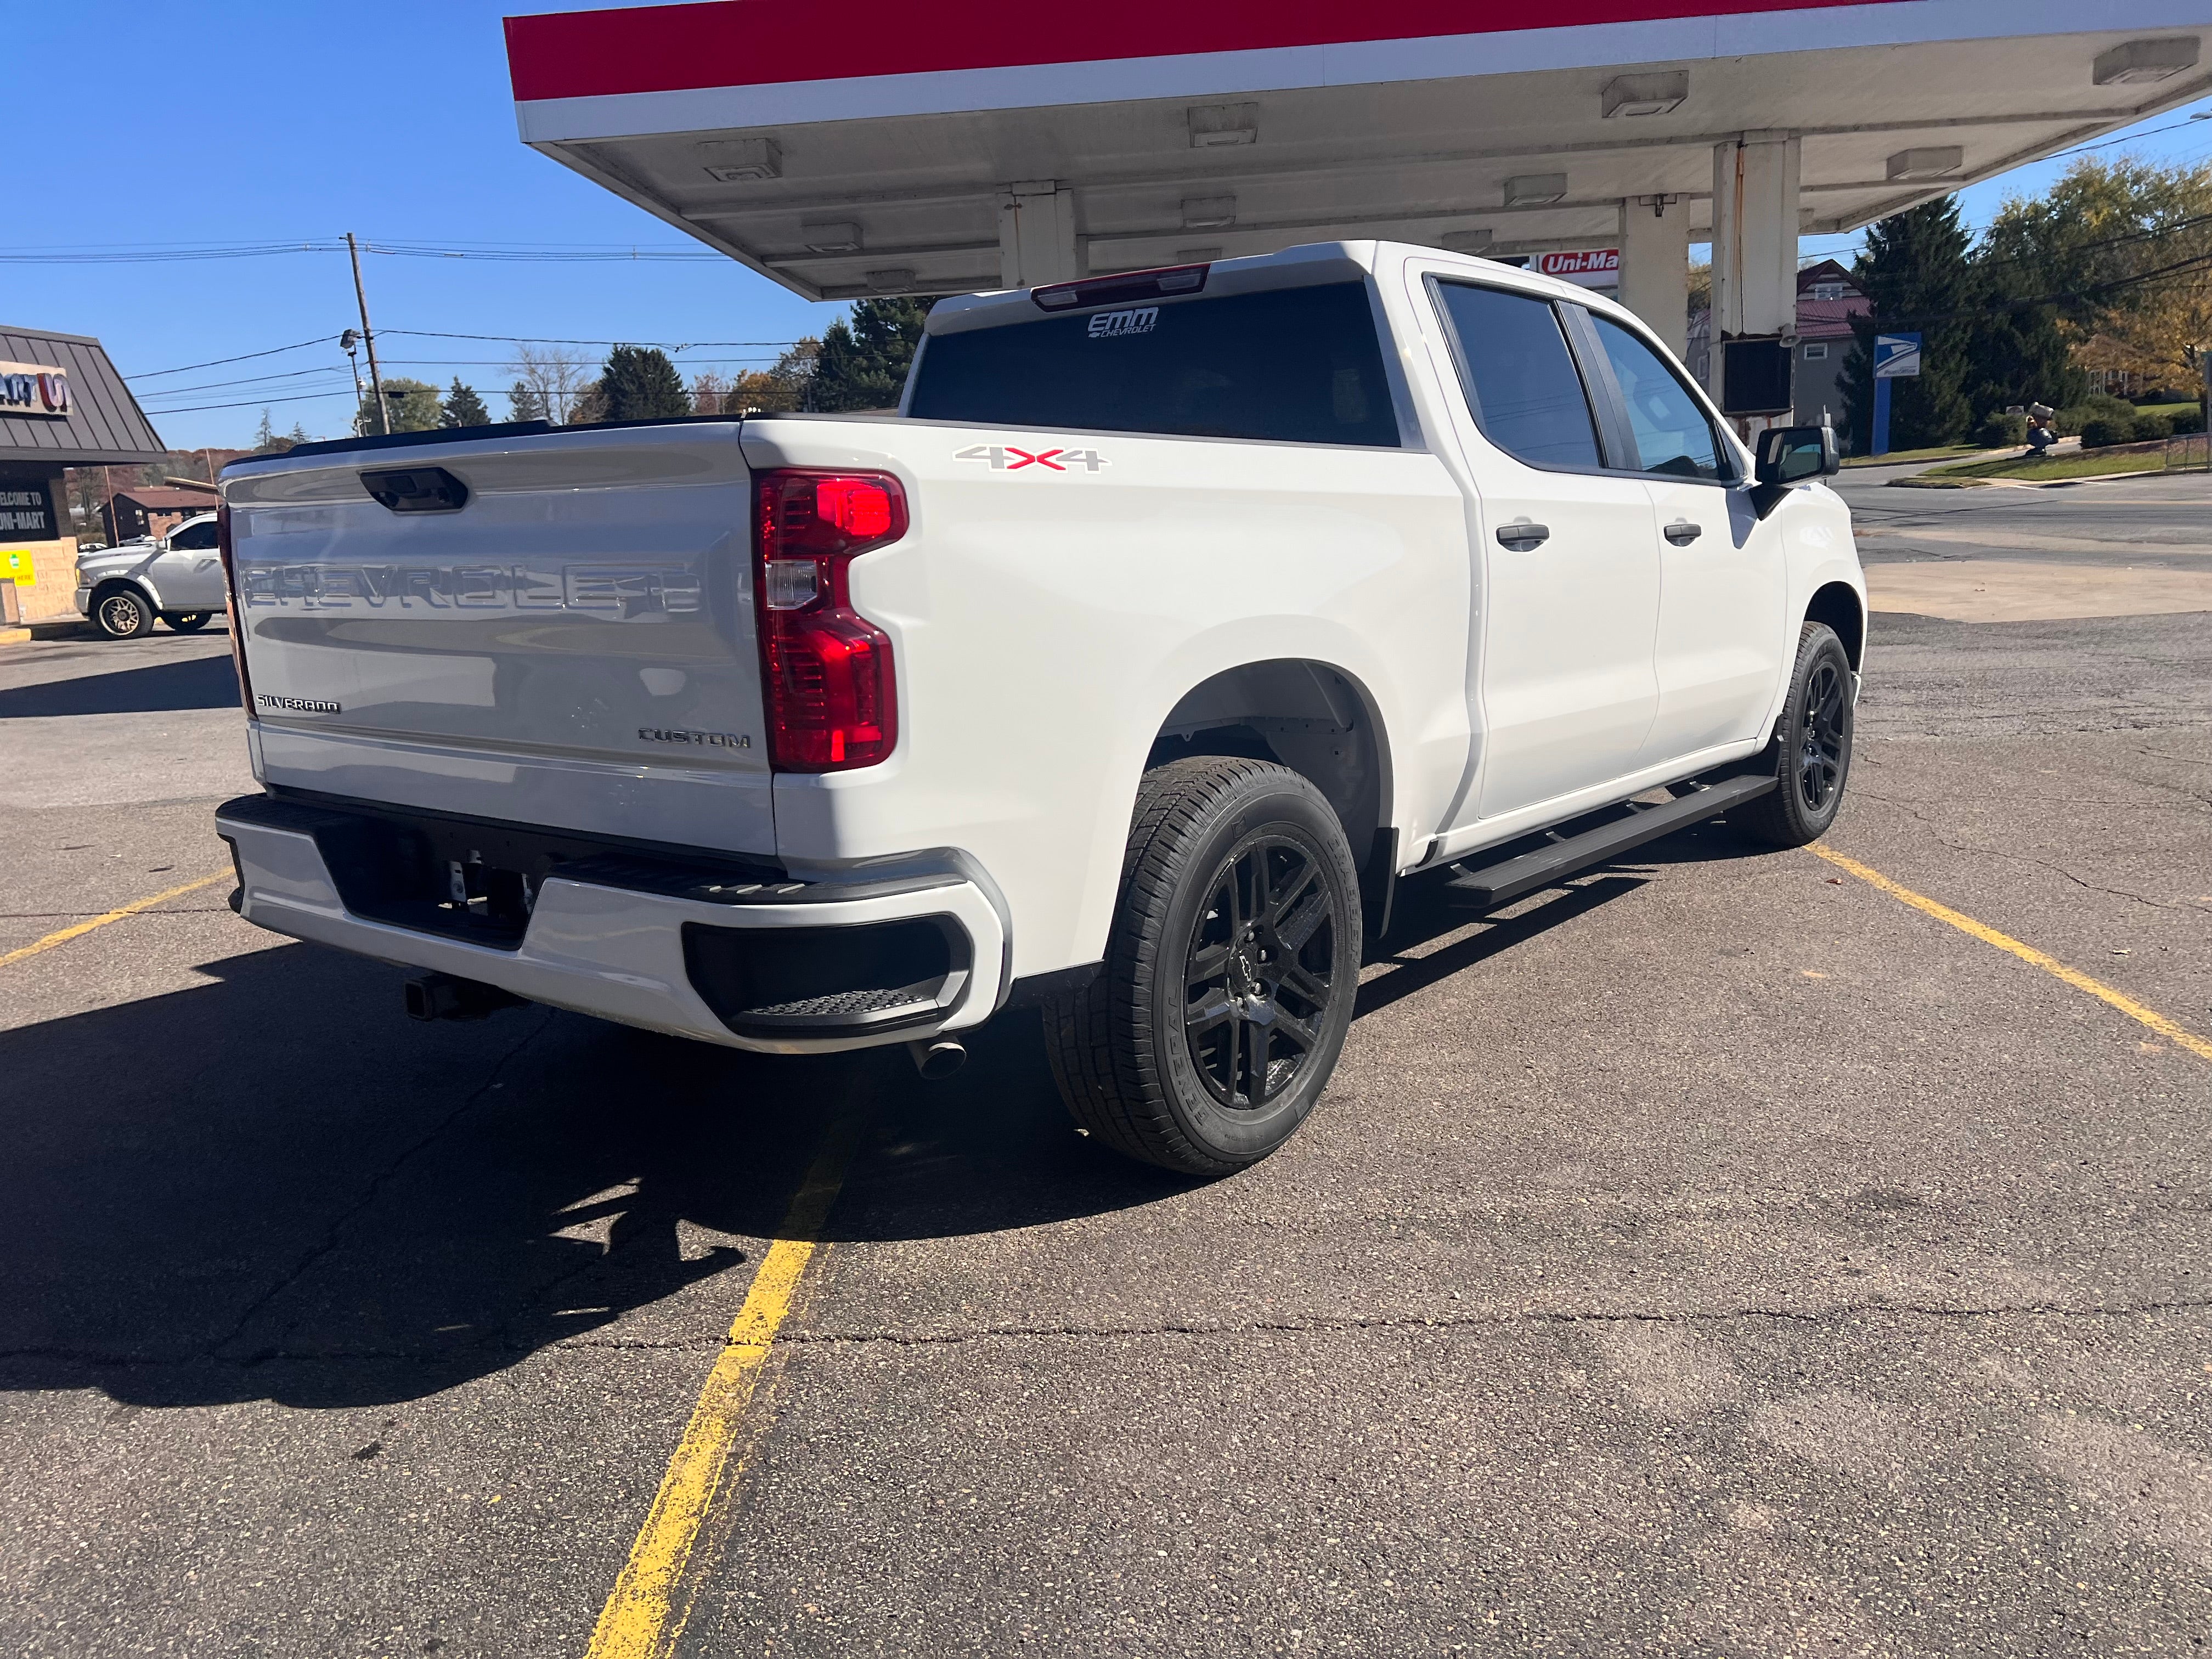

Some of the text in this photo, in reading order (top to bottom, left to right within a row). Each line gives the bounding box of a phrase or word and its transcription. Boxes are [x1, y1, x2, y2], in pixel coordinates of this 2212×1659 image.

[1101, 324, 1156, 337] CHEVROLET
[30, 492, 42, 505] TO
[246, 564, 686, 609] CHEVROLET
[256, 695, 343, 714] SILVERADO
[637, 728, 751, 749] CUSTOM
